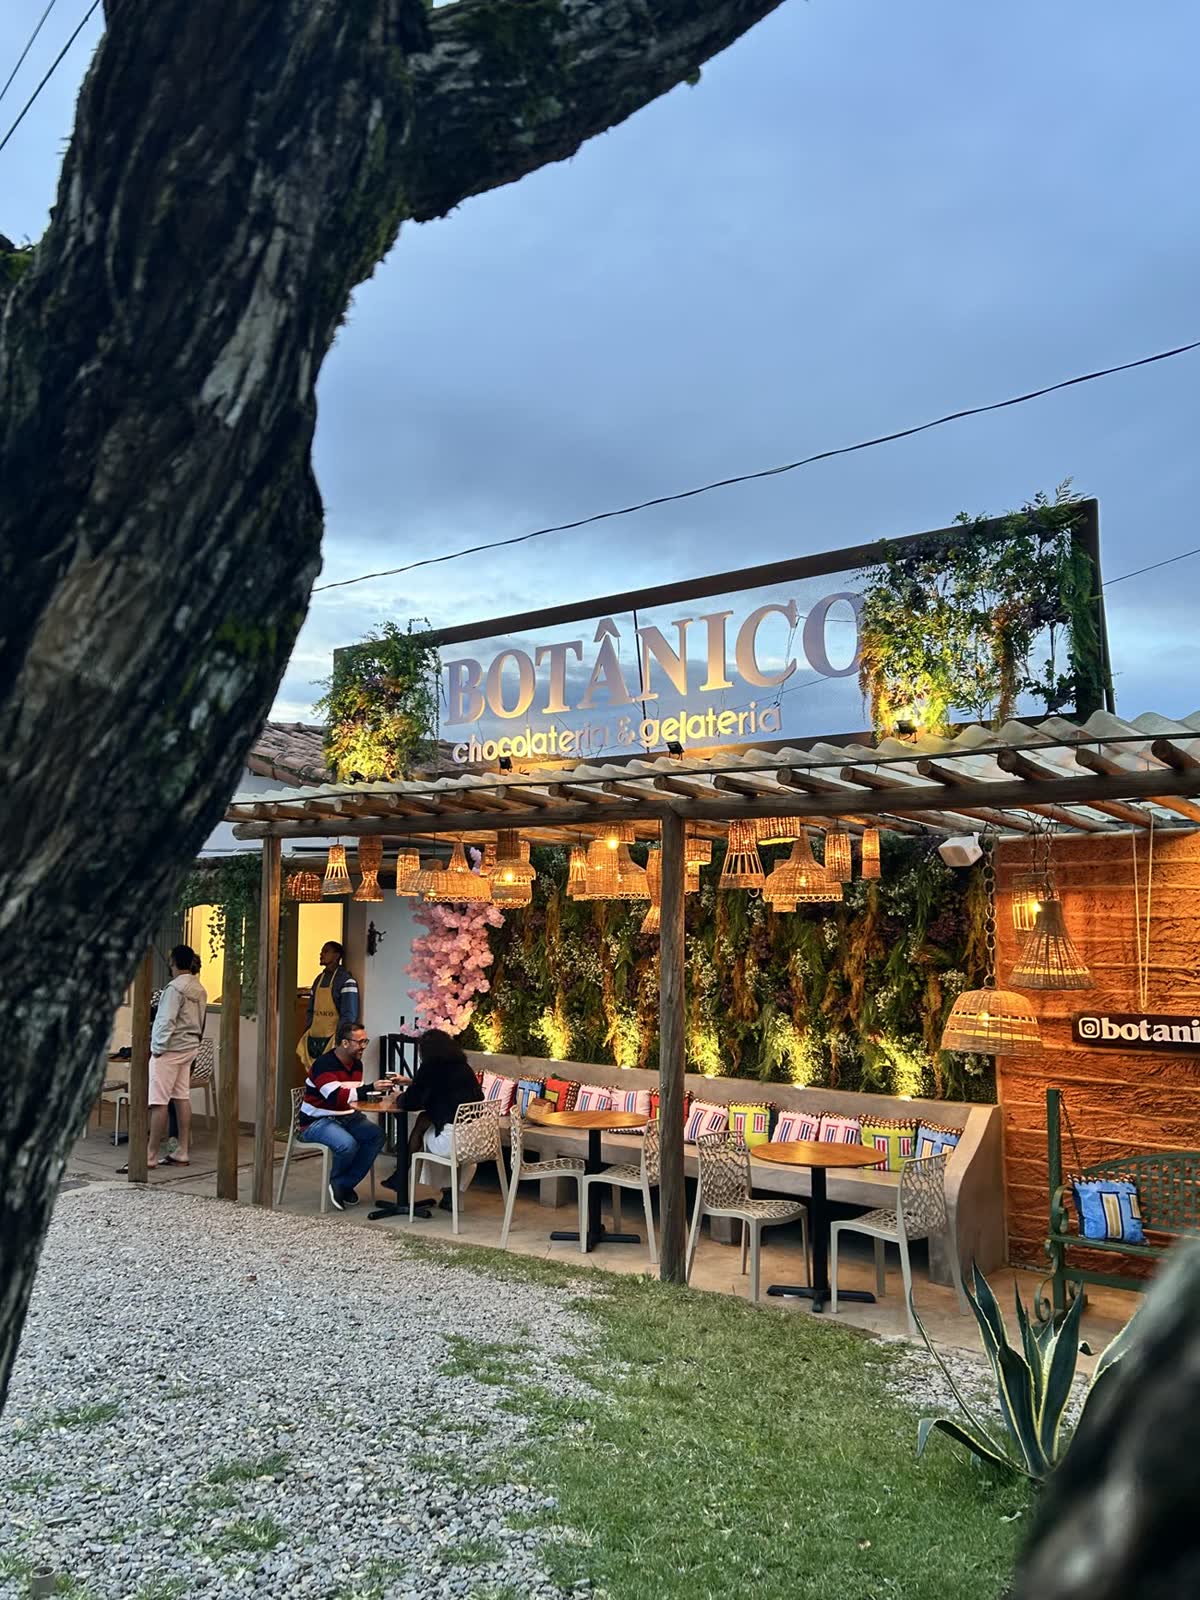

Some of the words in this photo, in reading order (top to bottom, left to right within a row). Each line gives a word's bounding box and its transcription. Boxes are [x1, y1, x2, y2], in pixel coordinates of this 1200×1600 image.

[443, 591, 865, 726] BOTÂNICO
[452, 721, 609, 764] chocolateria
[617, 716, 636, 746] &
[639, 701, 782, 749] gelateria
